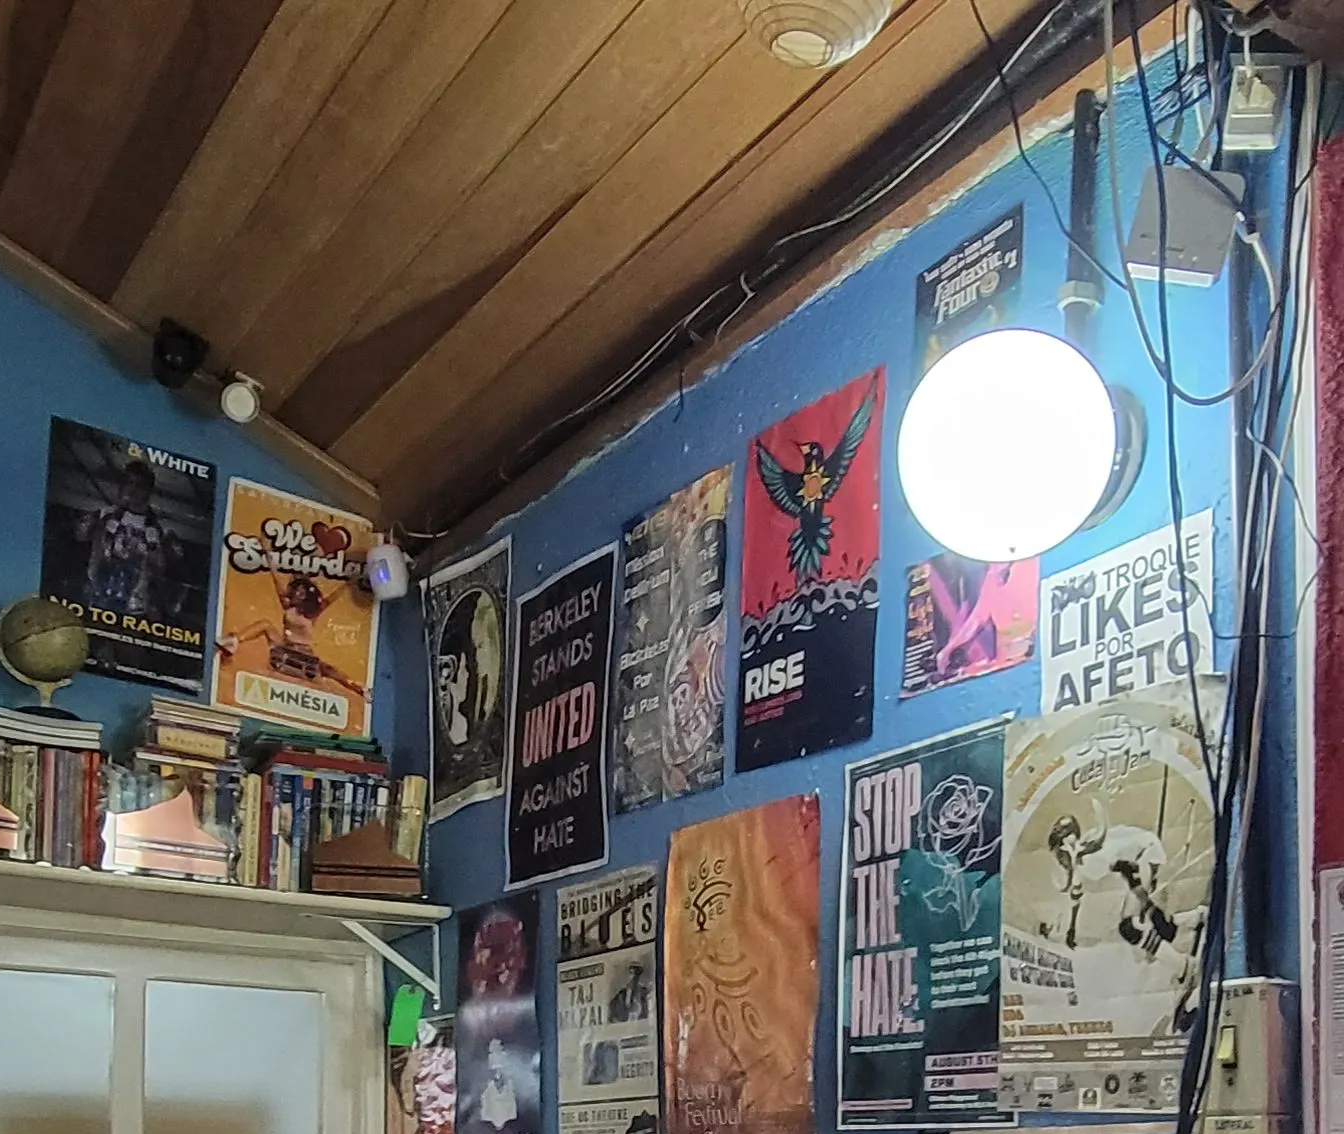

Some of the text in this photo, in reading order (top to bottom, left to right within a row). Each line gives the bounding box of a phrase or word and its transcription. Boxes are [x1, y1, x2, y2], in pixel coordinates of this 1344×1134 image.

[127, 442, 142, 458] &
[263, 518, 317, 552] We
[1102, 533, 1202, 592] TROQUE
[89, 607, 117, 625] TO
[122, 615, 202, 646] RACISM
[528, 580, 604, 649] BERKELEY
[1051, 560, 1201, 660] LIKES
[530, 631, 594, 688] STANDS
[1053, 630, 1202, 712] AFETO
[1094, 631, 1135, 661] POR
[744, 650, 806, 704] RISE
[522, 680, 596, 769] UNITED
[518, 761, 590, 818] AGAINST
[854, 762, 923, 863] STOP
[532, 816, 575, 857] HATE
[560, 888, 620, 920] BRIDGING
[561, 902, 653, 950] BLUES
[853, 857, 902, 950] THE
[568, 983, 594, 1006] TAJ
[850, 947, 925, 1038] HATE
